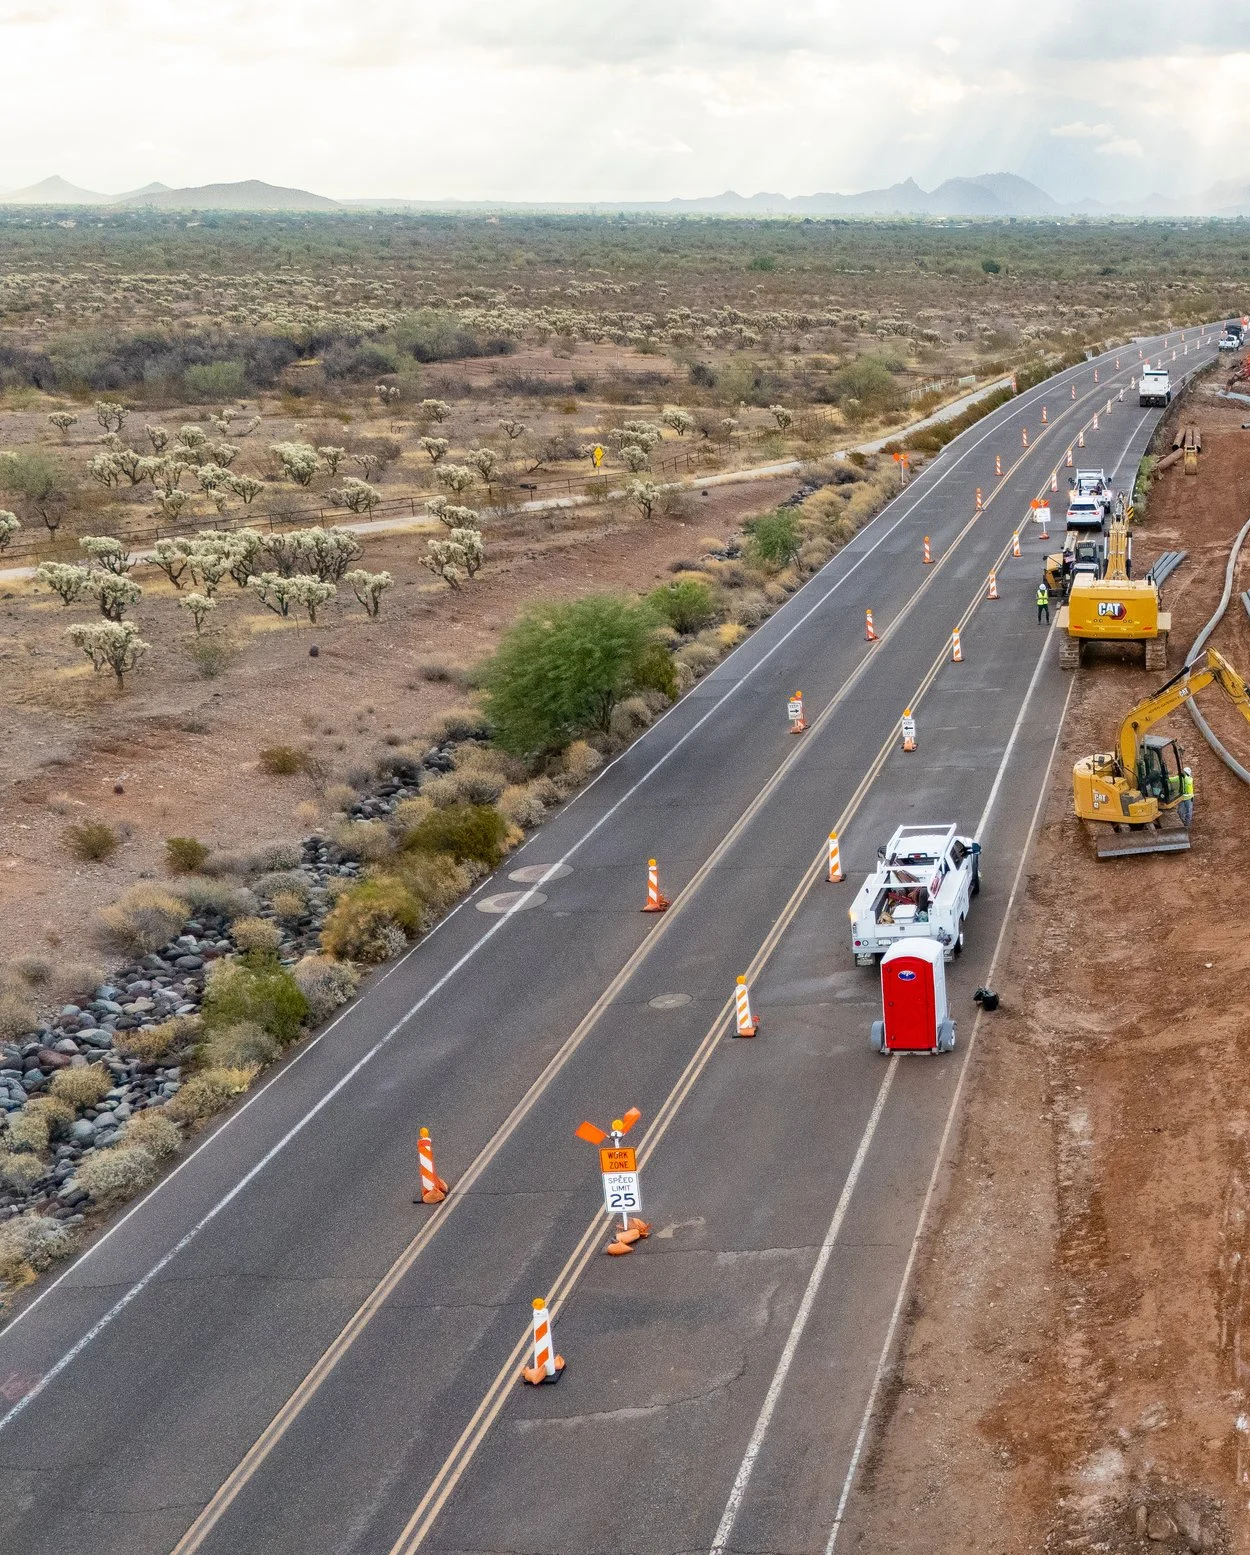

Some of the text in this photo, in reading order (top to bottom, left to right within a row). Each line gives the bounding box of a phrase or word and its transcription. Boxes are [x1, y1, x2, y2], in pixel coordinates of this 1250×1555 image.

[1098, 602, 1121, 616] CAT
[1094, 793, 1106, 802] CAT
[607, 1151, 628, 1160] WORK
[609, 1161, 629, 1169] ZONE
[608, 1176, 633, 1184] SPEED
[610, 1193, 636, 1208] 25
